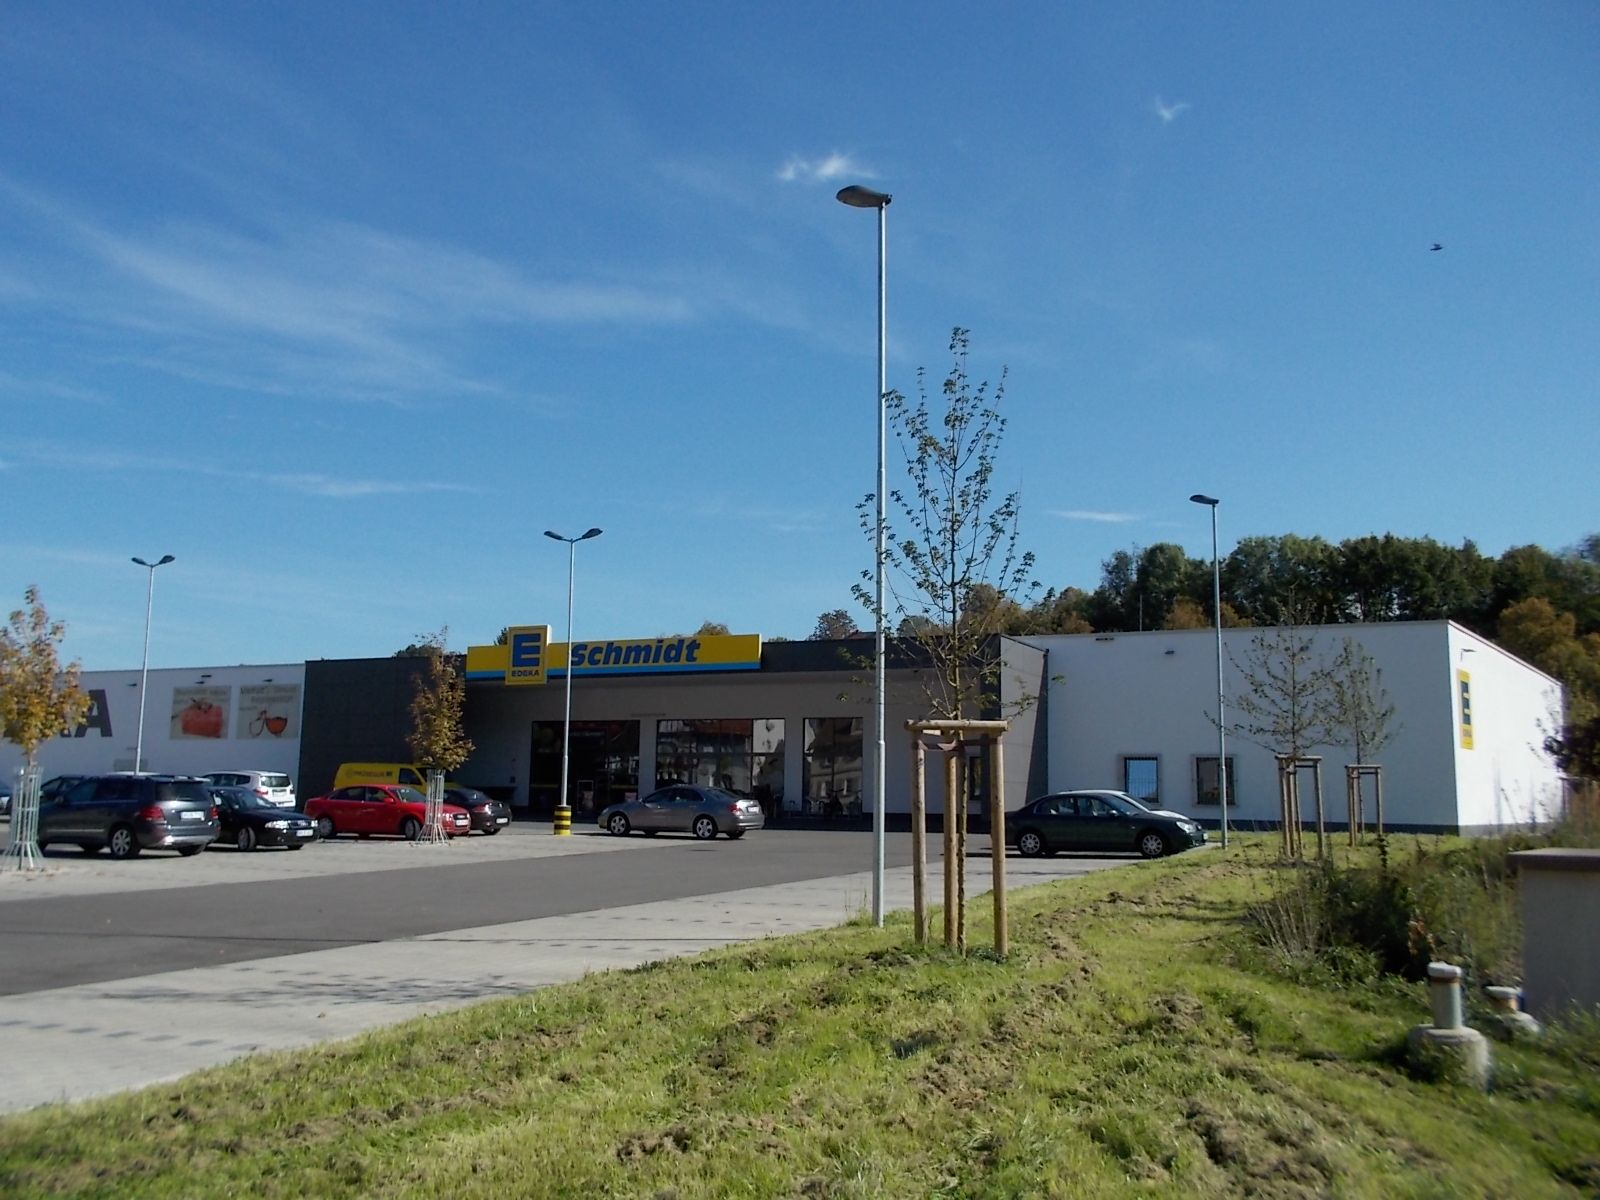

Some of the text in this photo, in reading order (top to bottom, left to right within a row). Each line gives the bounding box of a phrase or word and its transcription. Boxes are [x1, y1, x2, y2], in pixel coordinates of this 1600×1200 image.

[512, 633, 541, 667] E
[570, 639, 701, 666] Schmidt
[511, 669, 540, 677] EDEKA
